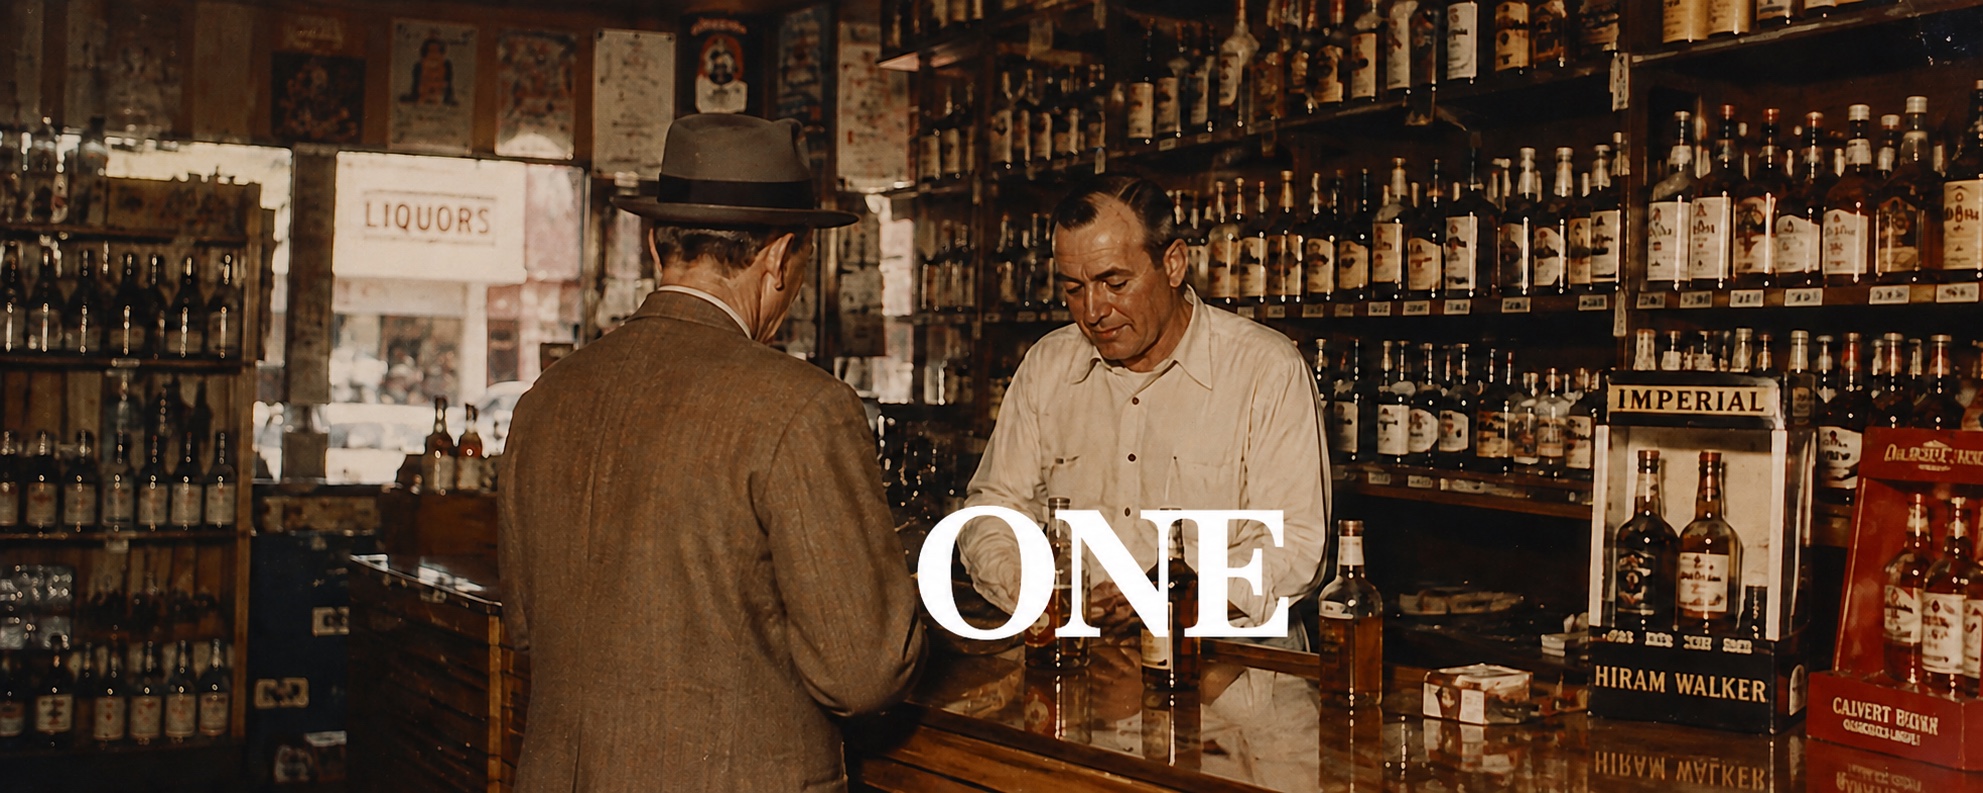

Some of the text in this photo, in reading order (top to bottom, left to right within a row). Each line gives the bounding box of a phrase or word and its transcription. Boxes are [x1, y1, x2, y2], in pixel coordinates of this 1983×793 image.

[366, 202, 489, 234] LIQUORS
[1617, 389, 1765, 412] IMPERIAL
[1595, 665, 1767, 703] HIRAM WALKER
